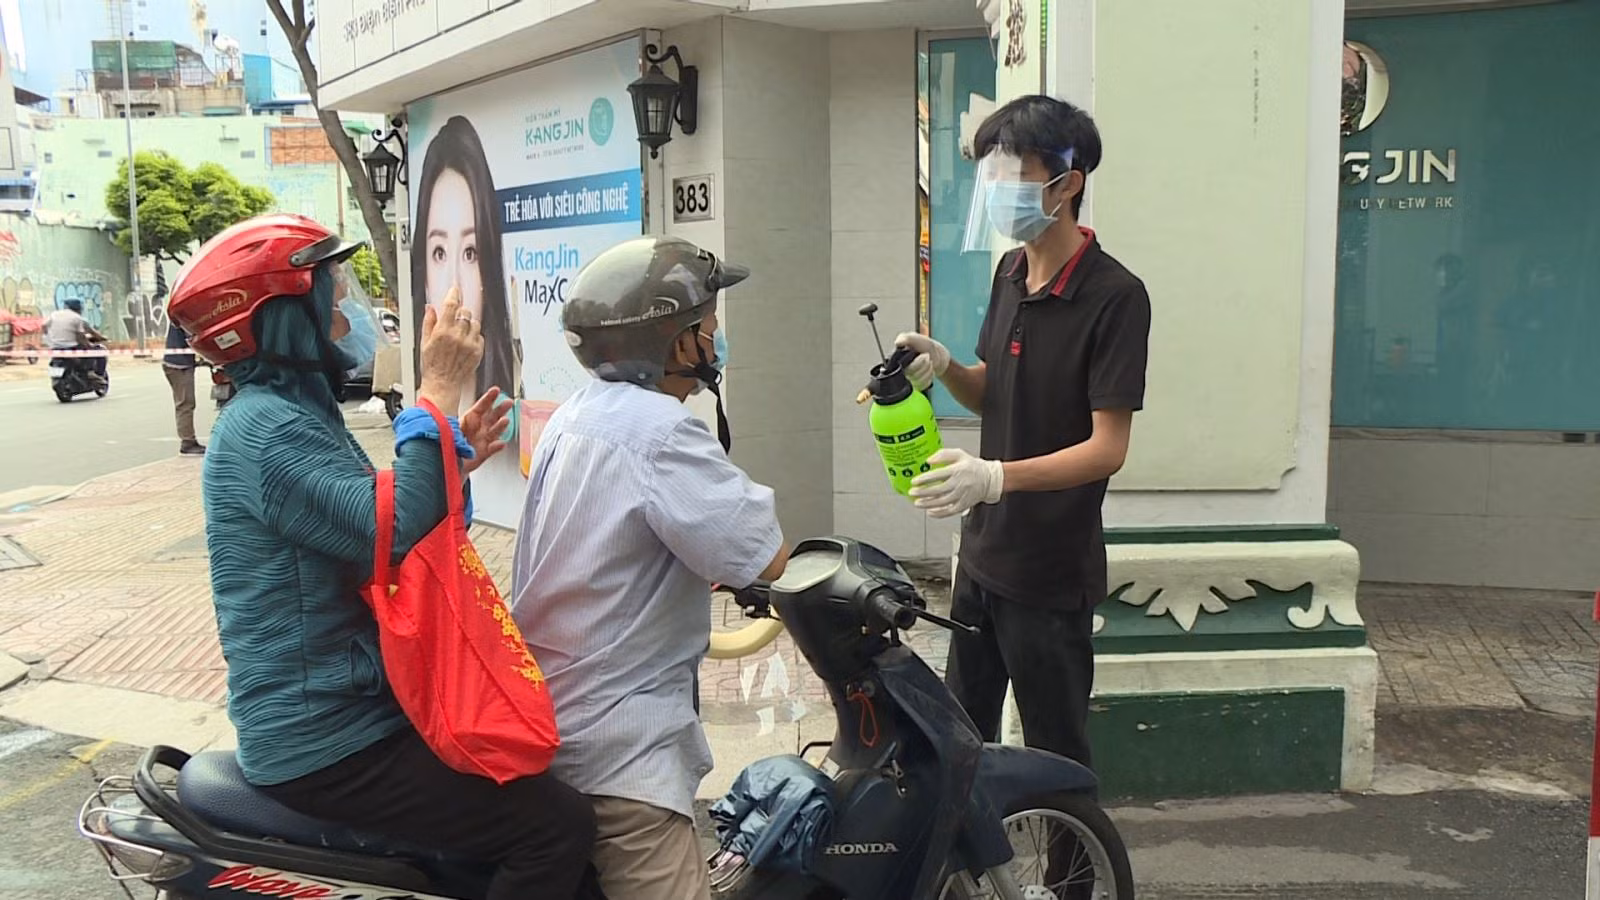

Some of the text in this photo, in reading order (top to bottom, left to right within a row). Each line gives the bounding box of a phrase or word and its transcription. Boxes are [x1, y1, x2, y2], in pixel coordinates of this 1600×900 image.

[525, 118, 584, 147] KANG JIN
[1376, 149, 1456, 184] JIN
[504, 182, 629, 223] TRẺ HÓA VỚI SIÊU CÔNG NGHỆ
[675, 183, 708, 214] 383
[515, 243, 579, 277] KangJin
[212, 297, 241, 315] Asia
[642, 305, 672, 320] Asia
[825, 843, 898, 854] HONDA
